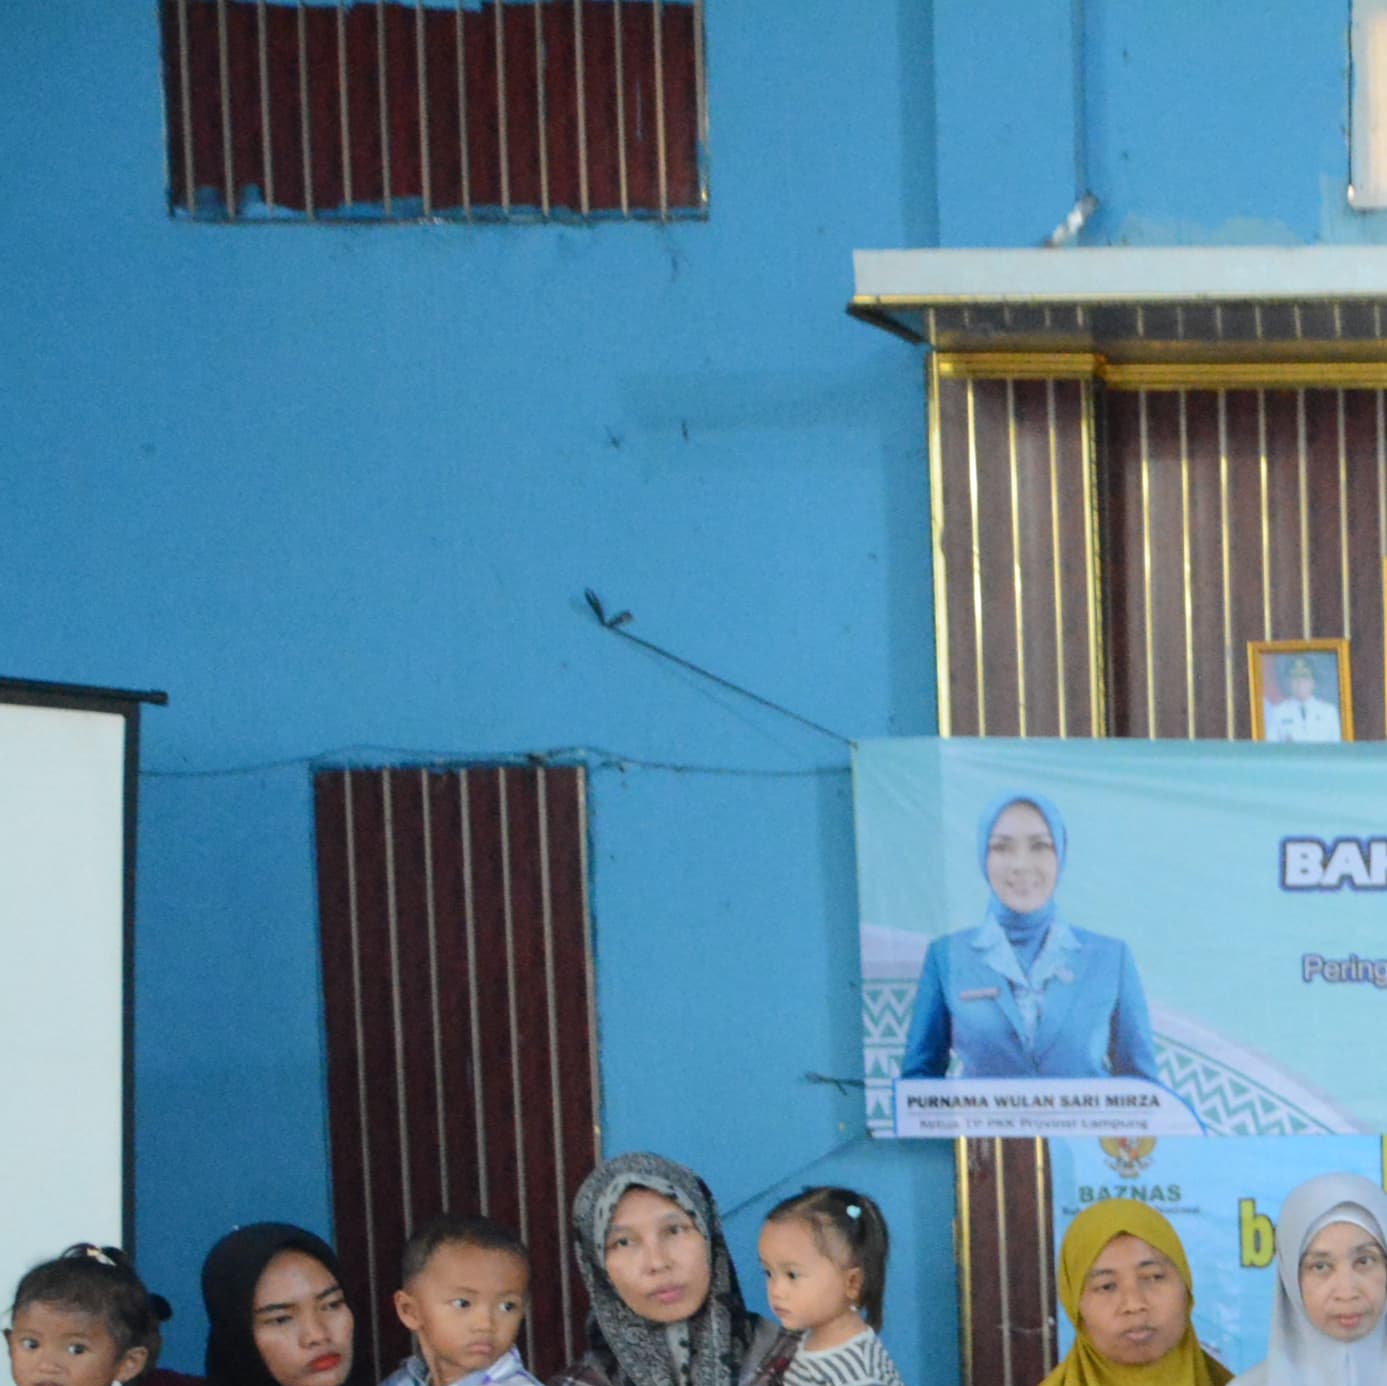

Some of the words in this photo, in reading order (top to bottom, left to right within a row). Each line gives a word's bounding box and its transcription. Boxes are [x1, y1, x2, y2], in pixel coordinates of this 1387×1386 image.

[907, 1095, 988, 1108] PURNAMA
[993, 1095, 1054, 1108] WULAN
[1060, 1095, 1100, 1107] SARI
[1105, 1095, 1160, 1107] MIRZA
[1078, 1185, 1182, 1202] BAZNAS
